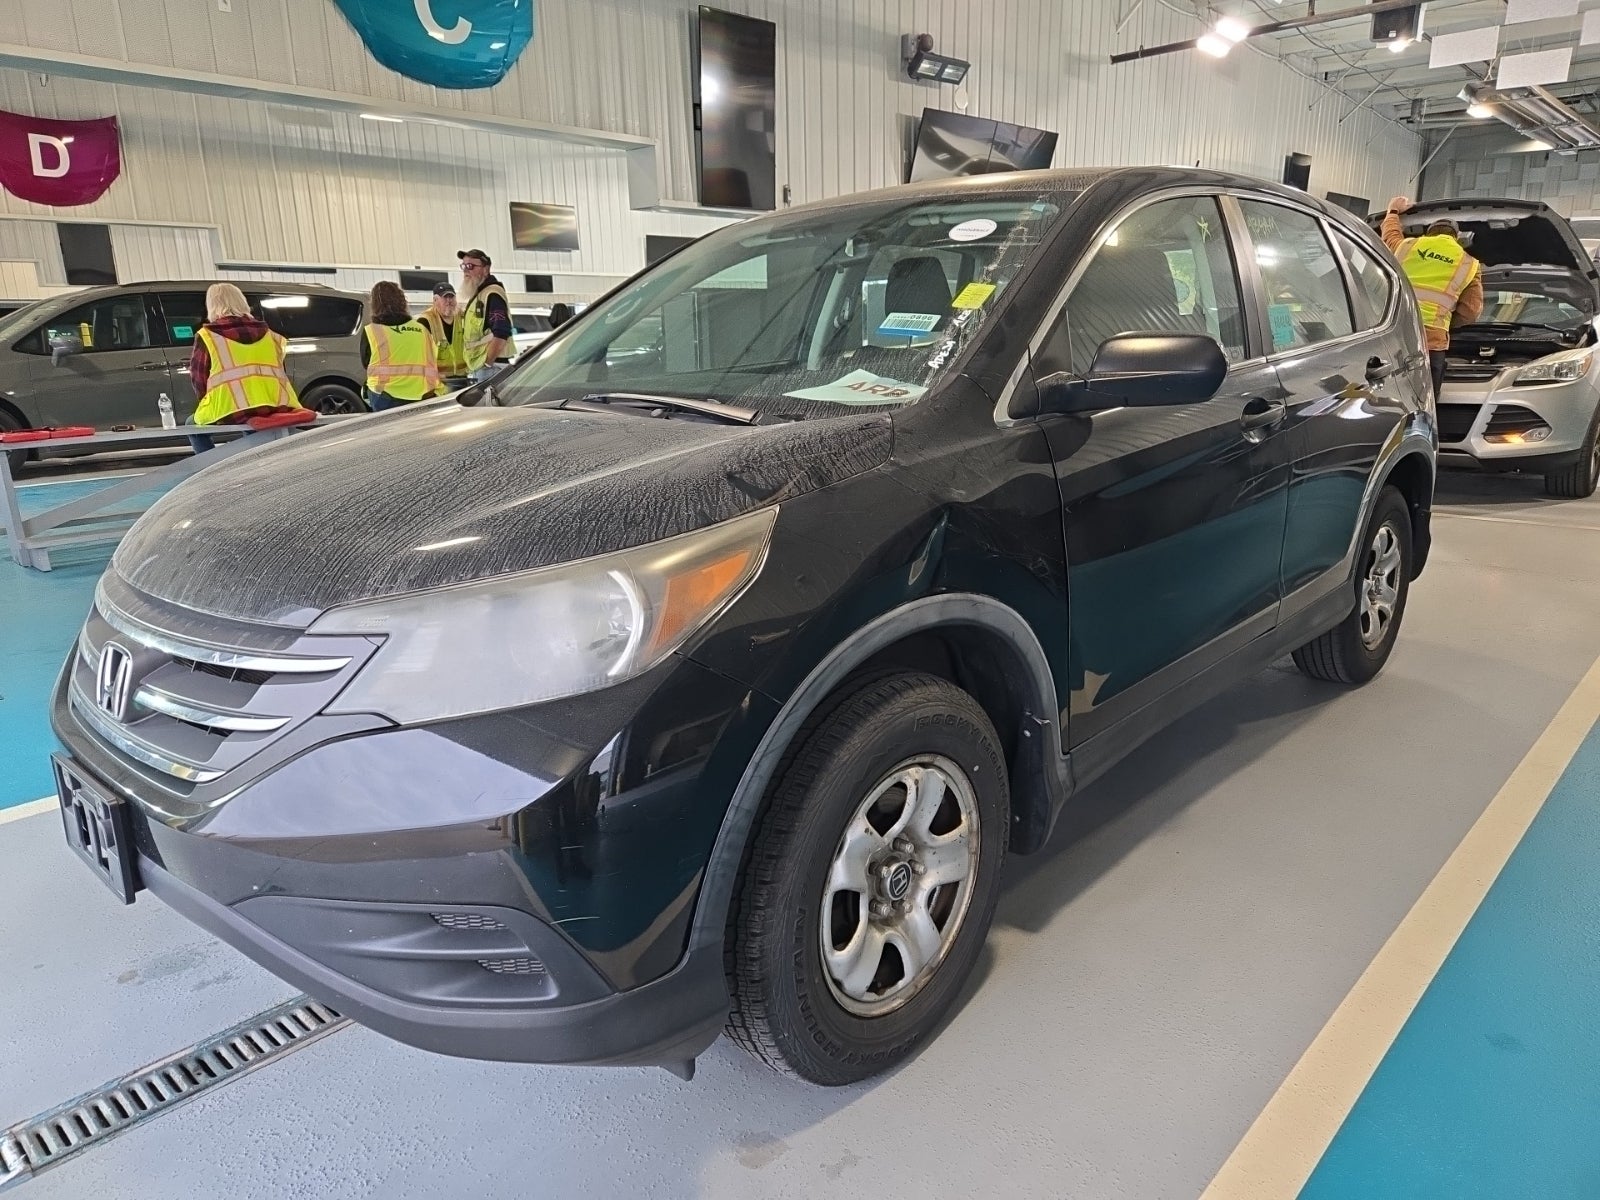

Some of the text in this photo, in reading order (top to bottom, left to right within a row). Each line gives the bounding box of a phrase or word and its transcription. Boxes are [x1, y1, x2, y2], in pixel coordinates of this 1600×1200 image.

[27, 132, 71, 178] D
[1426, 251, 1454, 264] ADESA
[928, 340, 957, 369] ADESA
[792, 906, 842, 1057] MOUNTAIN
